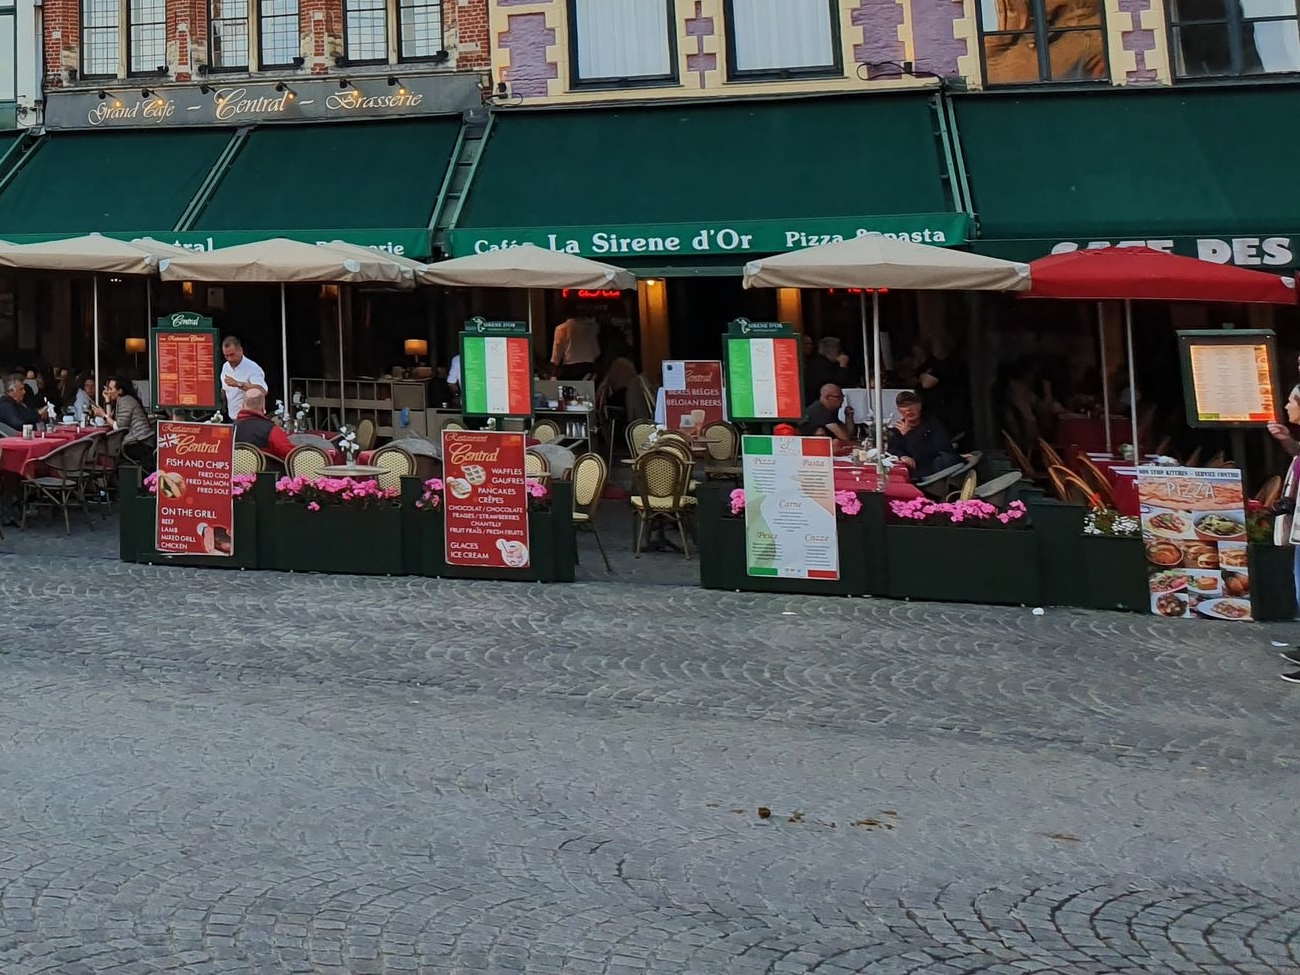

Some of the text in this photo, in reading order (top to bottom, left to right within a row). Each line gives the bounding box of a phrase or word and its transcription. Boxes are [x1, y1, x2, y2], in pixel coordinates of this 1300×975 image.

[87, 99, 140, 126] Grand
[213, 88, 288, 121] Central
[325, 90, 423, 111] Brasserie
[548, 234, 581, 254] La
[592, 233, 680, 253] Sirene
[692, 229, 752, 250] d'Or
[785, 231, 844, 248] Pizza
[1197, 237, 1293, 266] DES
[171, 313, 200, 327] Central
[667, 398, 699, 406] BELGIAN
[176, 434, 221, 455] Central
[449, 443, 500, 465] Central
[166, 458, 230, 470] FISH AND CHIPS
[491, 468, 523, 476] WAFFLES
[491, 477, 525, 485] GAUFRES
[478, 487, 516, 495] PANCAKES
[1166, 481, 1215, 499] PIZZA
[161, 507, 217, 519] ON THE GRILL
[479, 513, 520, 521] STRAWBERRIES
[470, 520, 502, 528] CHANTILLY
